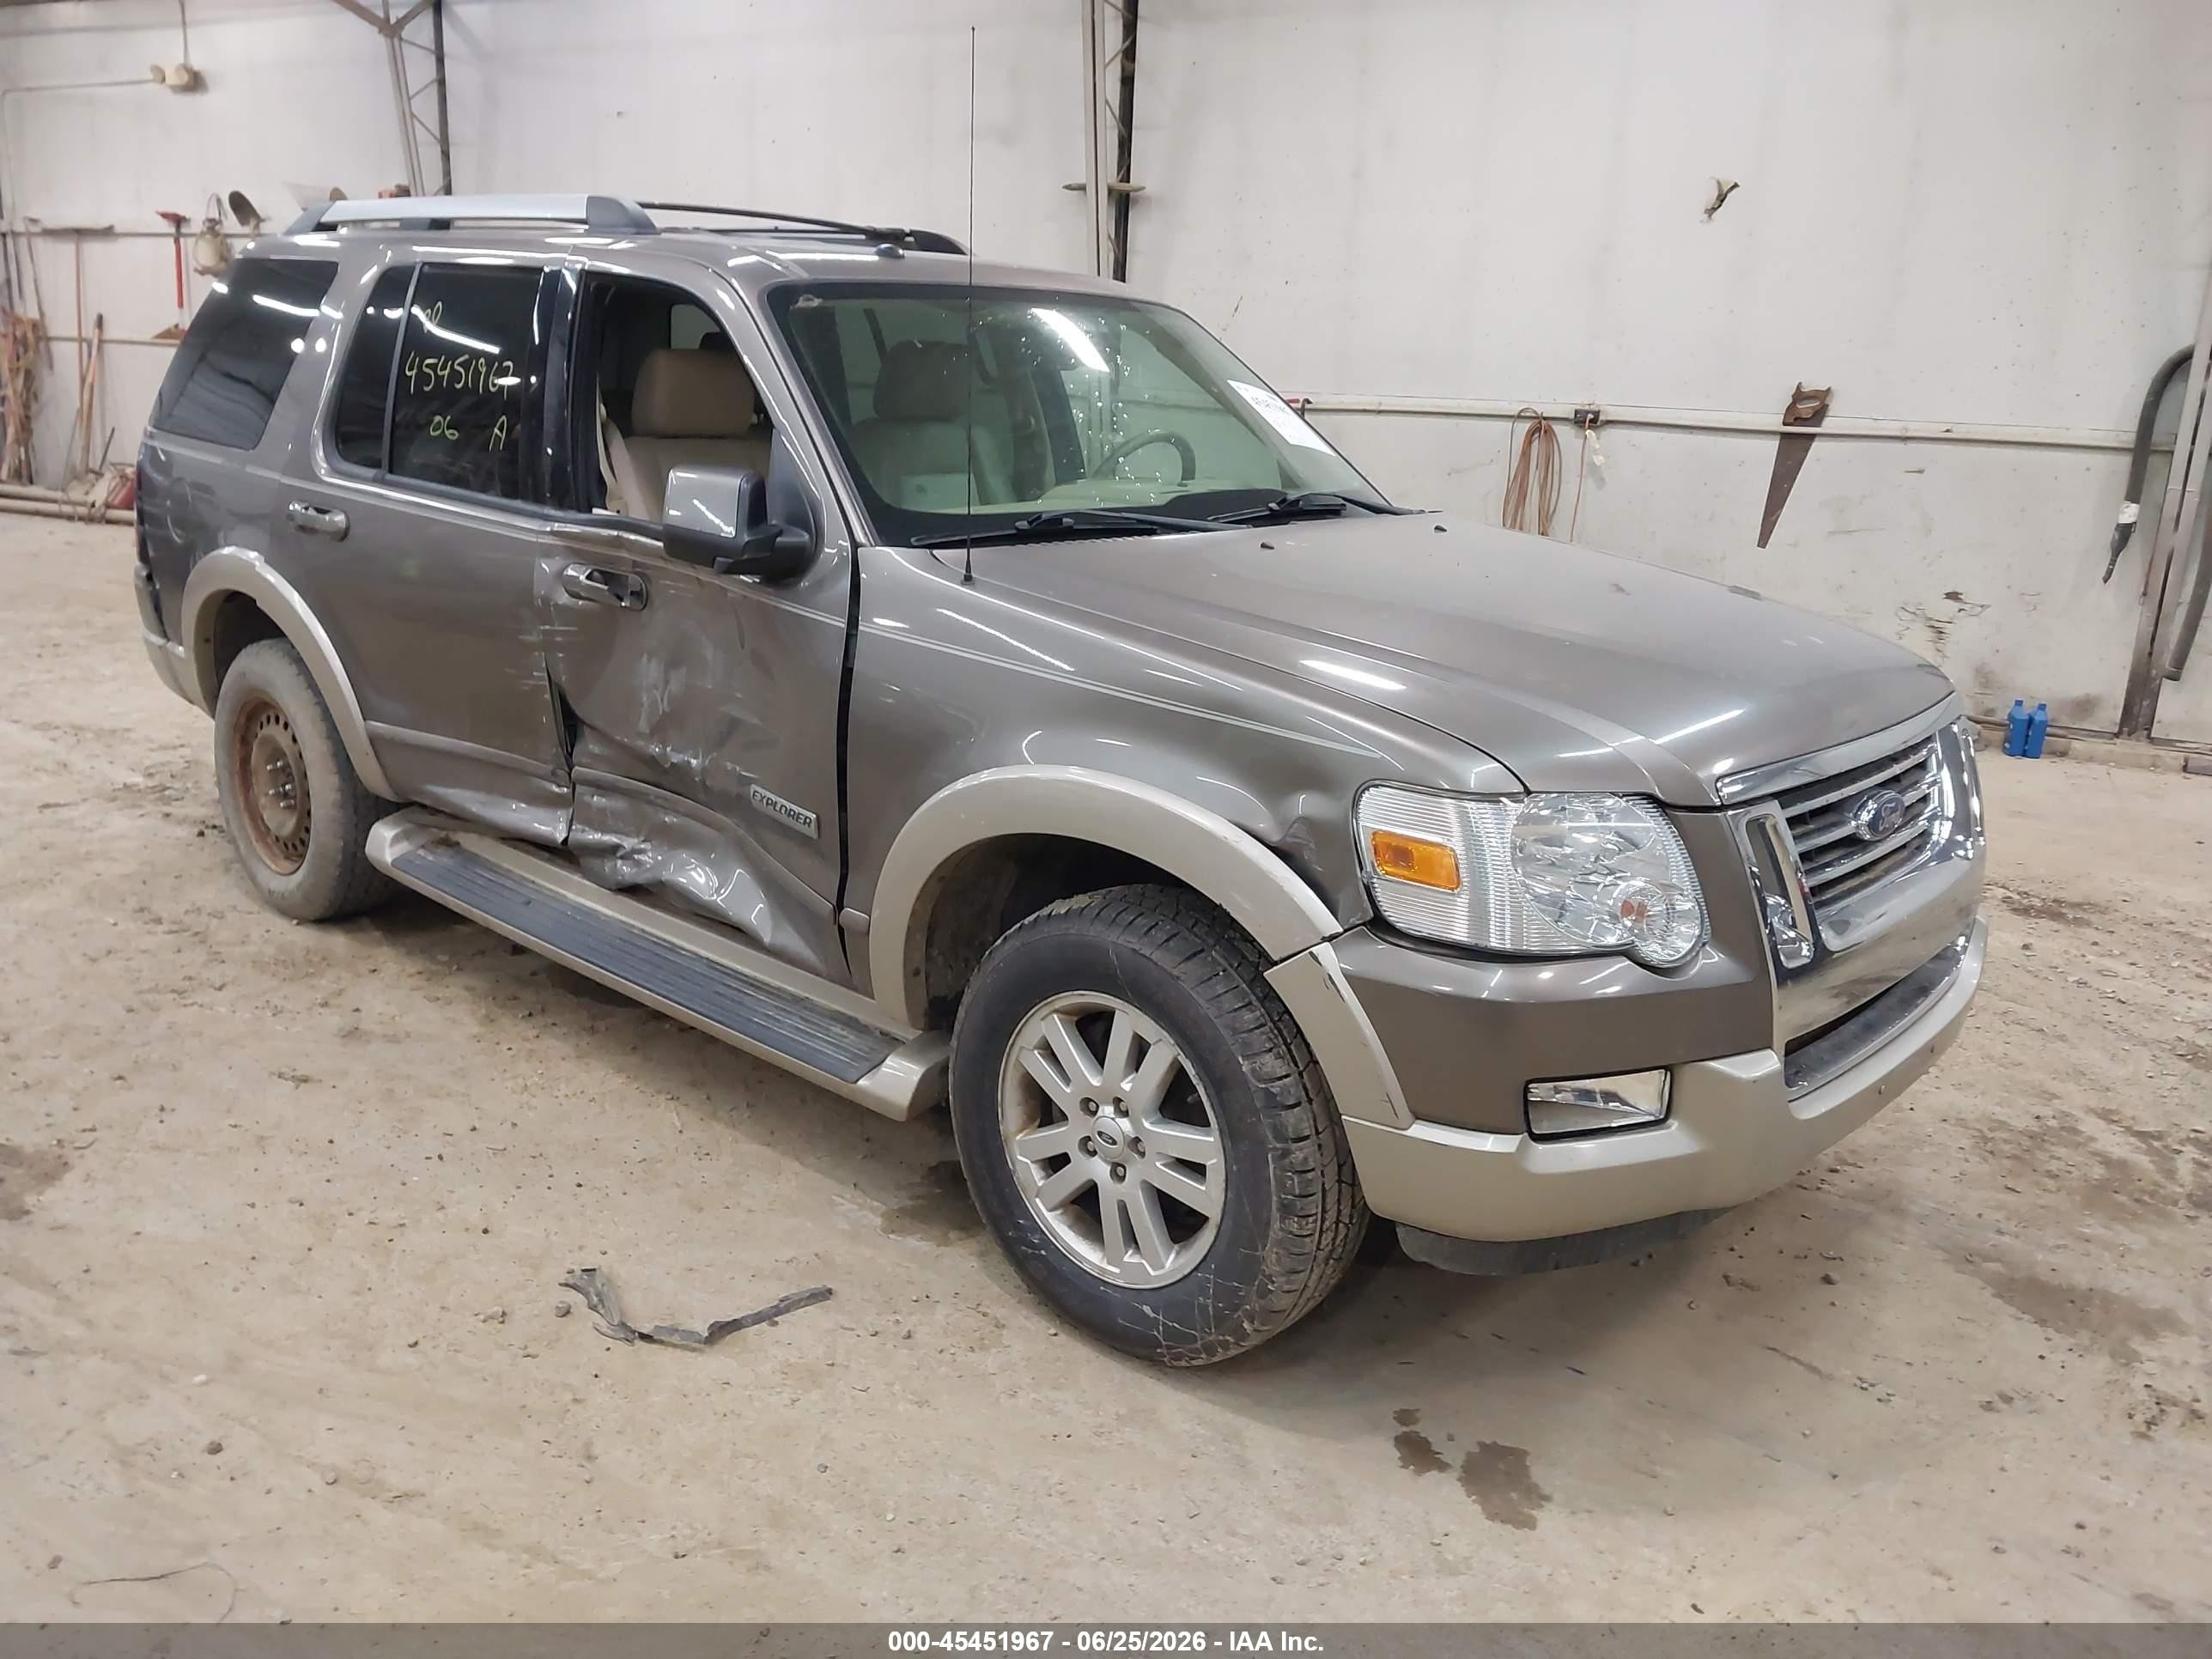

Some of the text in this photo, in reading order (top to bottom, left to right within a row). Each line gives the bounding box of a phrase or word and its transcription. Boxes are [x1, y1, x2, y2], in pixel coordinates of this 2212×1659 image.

[404, 350, 514, 400] 45451967
[429, 415, 507, 452] 06 A
[752, 789, 812, 828] EXPLORER
